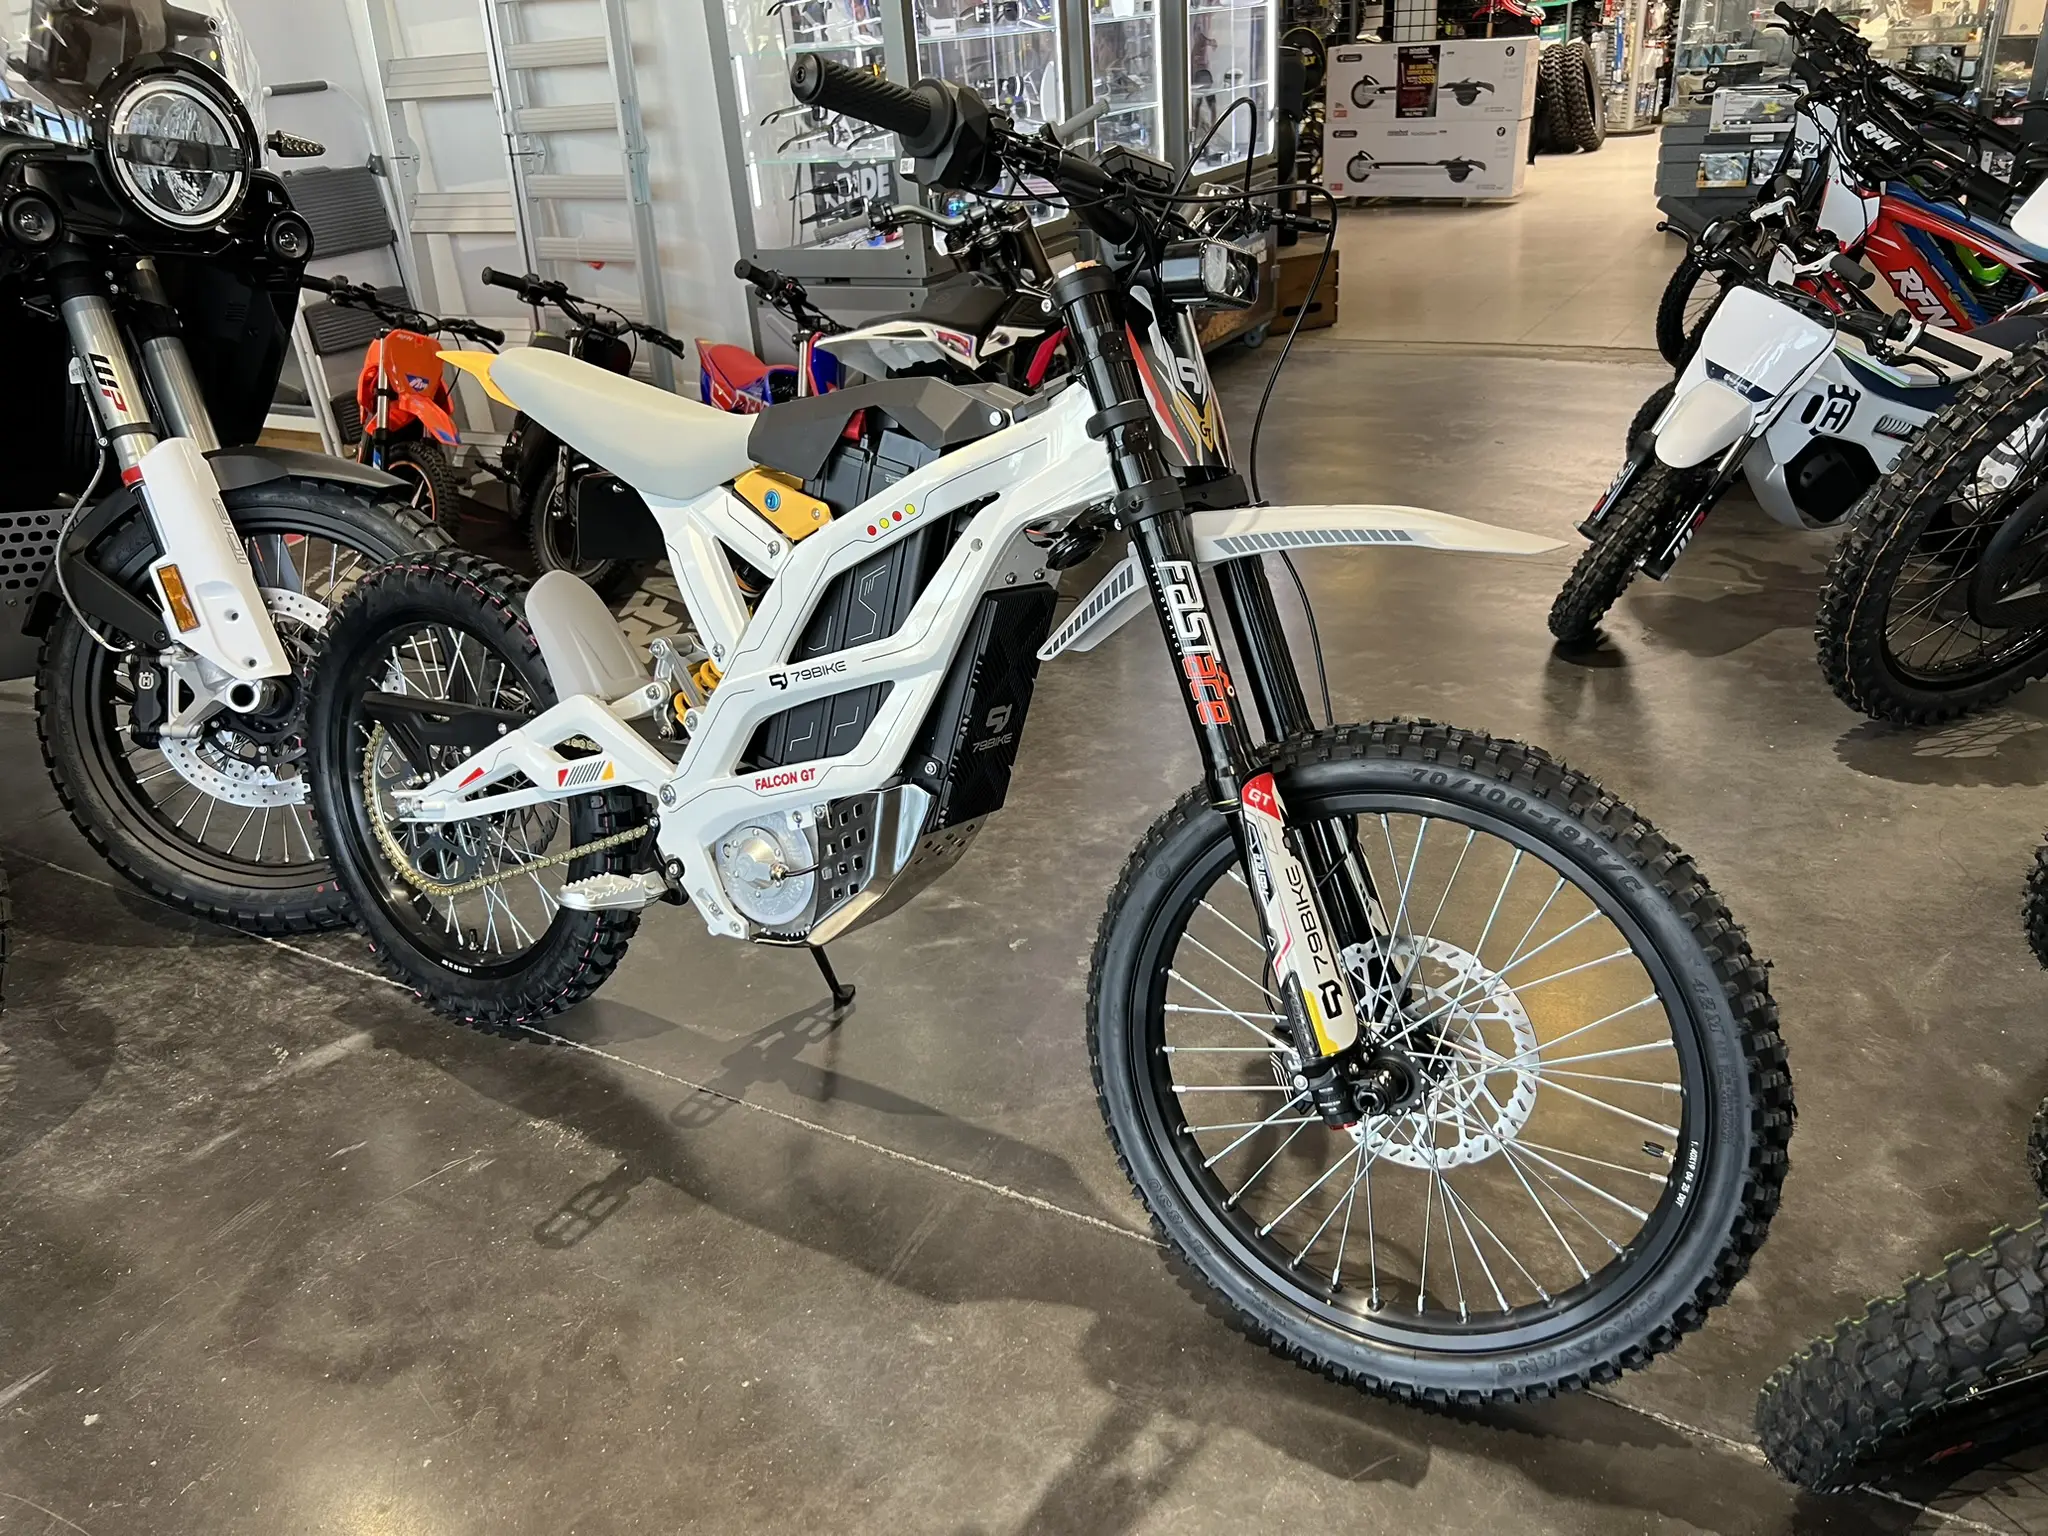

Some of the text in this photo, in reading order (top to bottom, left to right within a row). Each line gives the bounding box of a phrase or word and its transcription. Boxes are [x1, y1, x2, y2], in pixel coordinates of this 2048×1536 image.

[1880, 75, 1925, 100] RFN
[1856, 121, 1901, 151] RFN
[1888, 267, 1957, 327] RFN
[1150, 562, 1183, 656] PERFORMANCE
[790, 660, 847, 683] 79BIKE
[973, 732, 1013, 753] 79BIKE
[755, 768, 816, 791] FALCON GT
[1248, 788, 1272, 807] GT
[1285, 864, 1329, 975] 79BIKE
